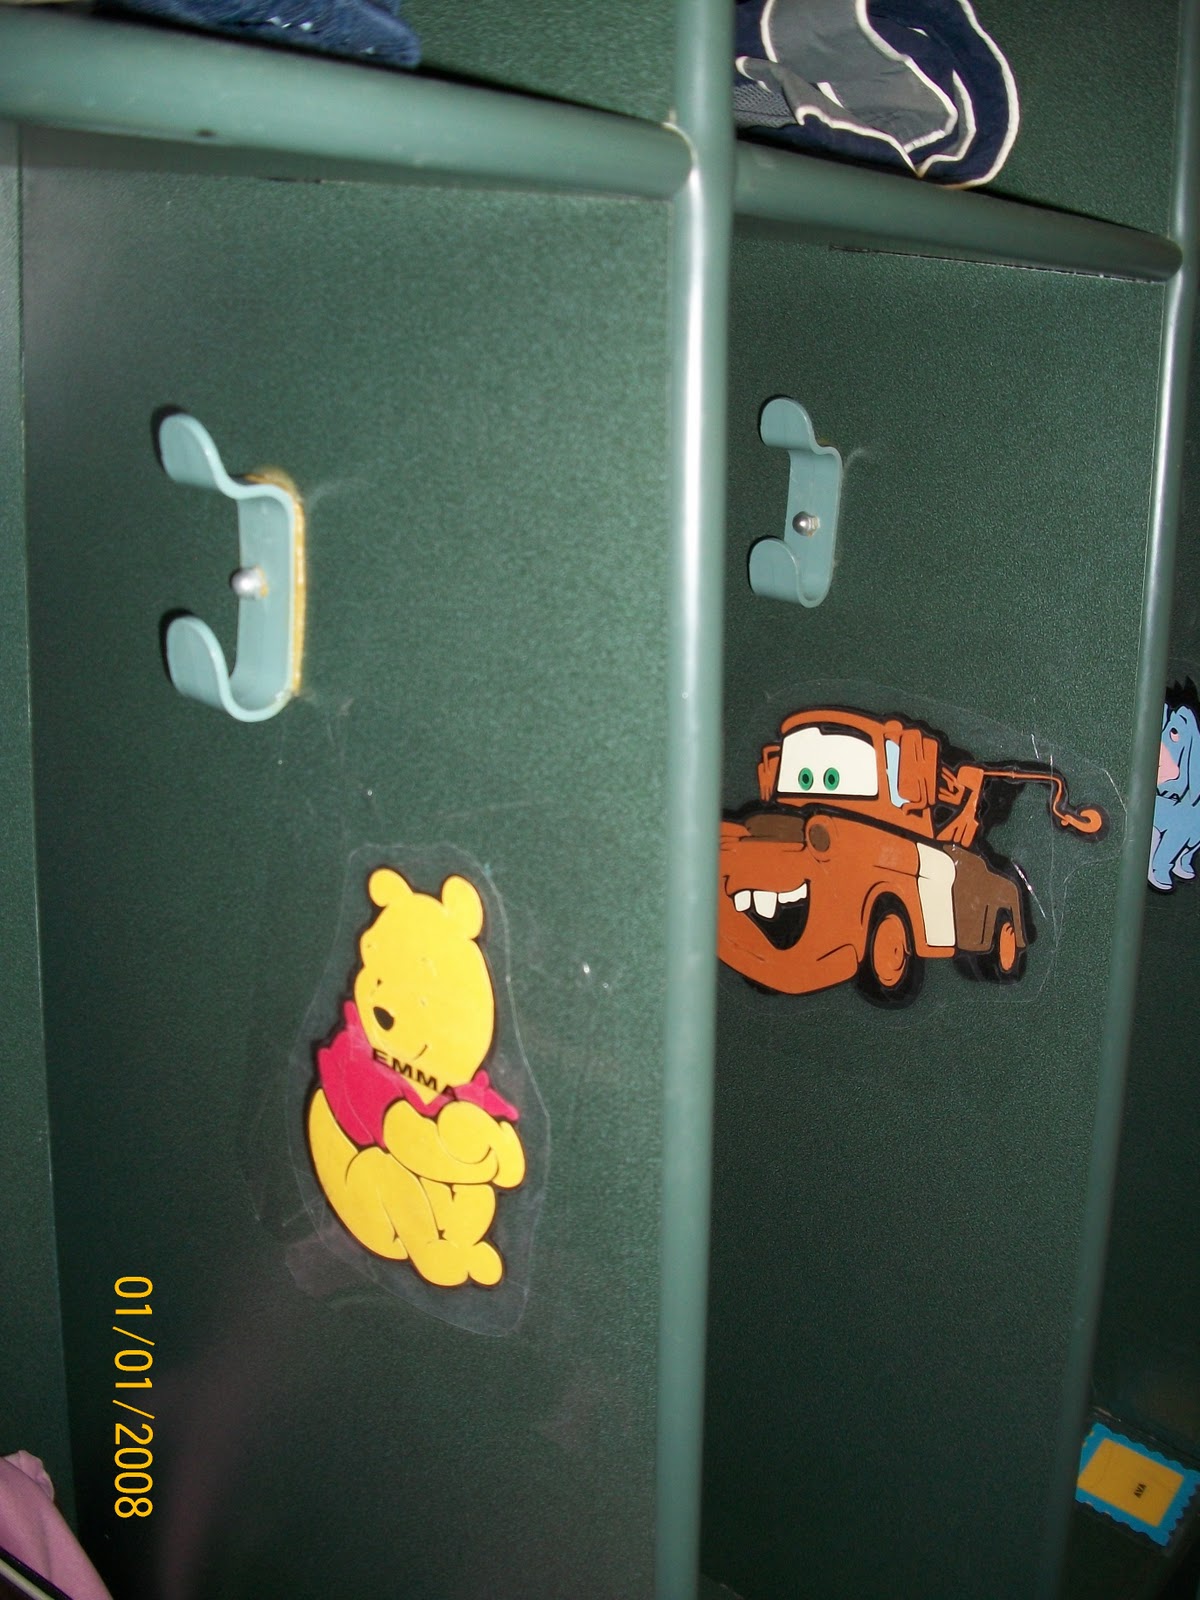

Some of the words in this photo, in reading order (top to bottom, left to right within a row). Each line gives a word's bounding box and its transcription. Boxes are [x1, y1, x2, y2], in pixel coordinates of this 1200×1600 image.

[1156, 787, 1181, 802] VA
[373, 1047, 459, 1102] EMMA
[1133, 1483, 1147, 1498] AVA
